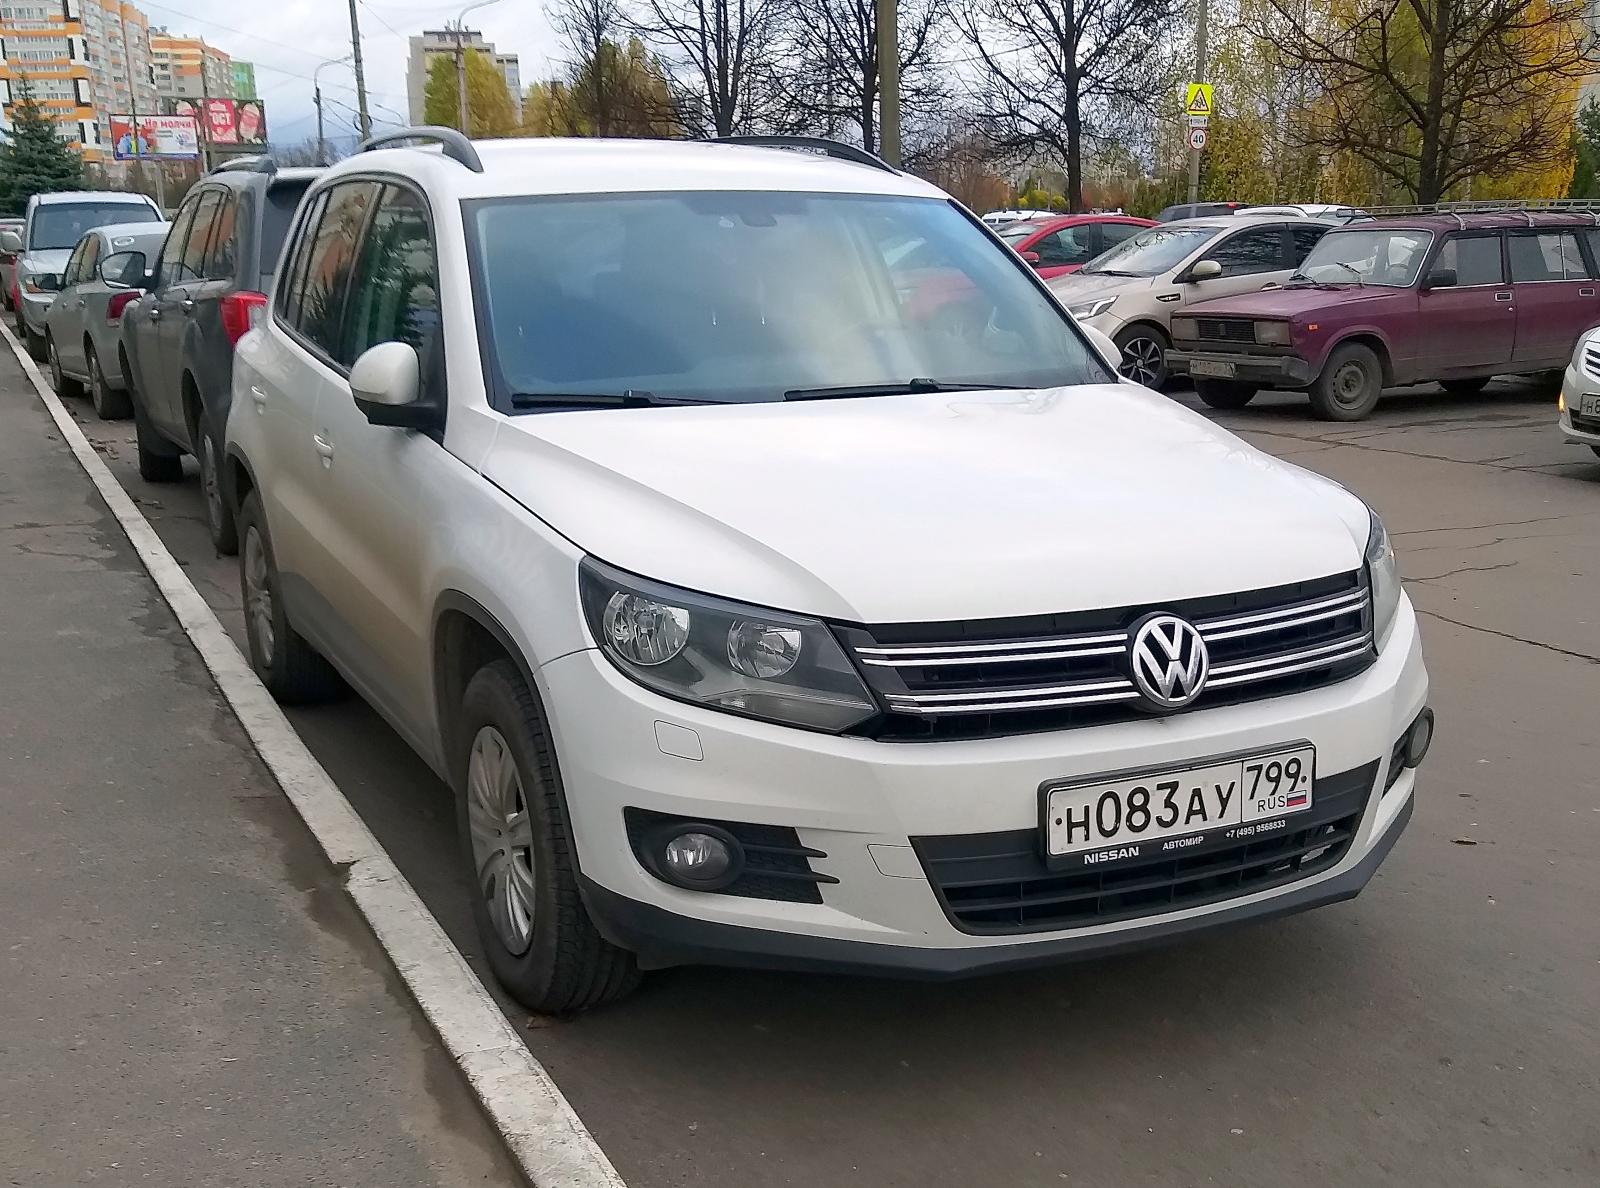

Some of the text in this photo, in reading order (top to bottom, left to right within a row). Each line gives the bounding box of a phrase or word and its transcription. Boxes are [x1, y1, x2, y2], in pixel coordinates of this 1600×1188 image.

[1193, 135, 1203, 143] 40
[1066, 757, 1302, 844] Н083АУ 799
[1257, 795, 1286, 813] RUS
[1225, 829, 1236, 838] +7
[1236, 826, 1255, 838] (495)
[1162, 836, 1204, 850] АВТОМИР
[1084, 846, 1139, 864] NISSAN
